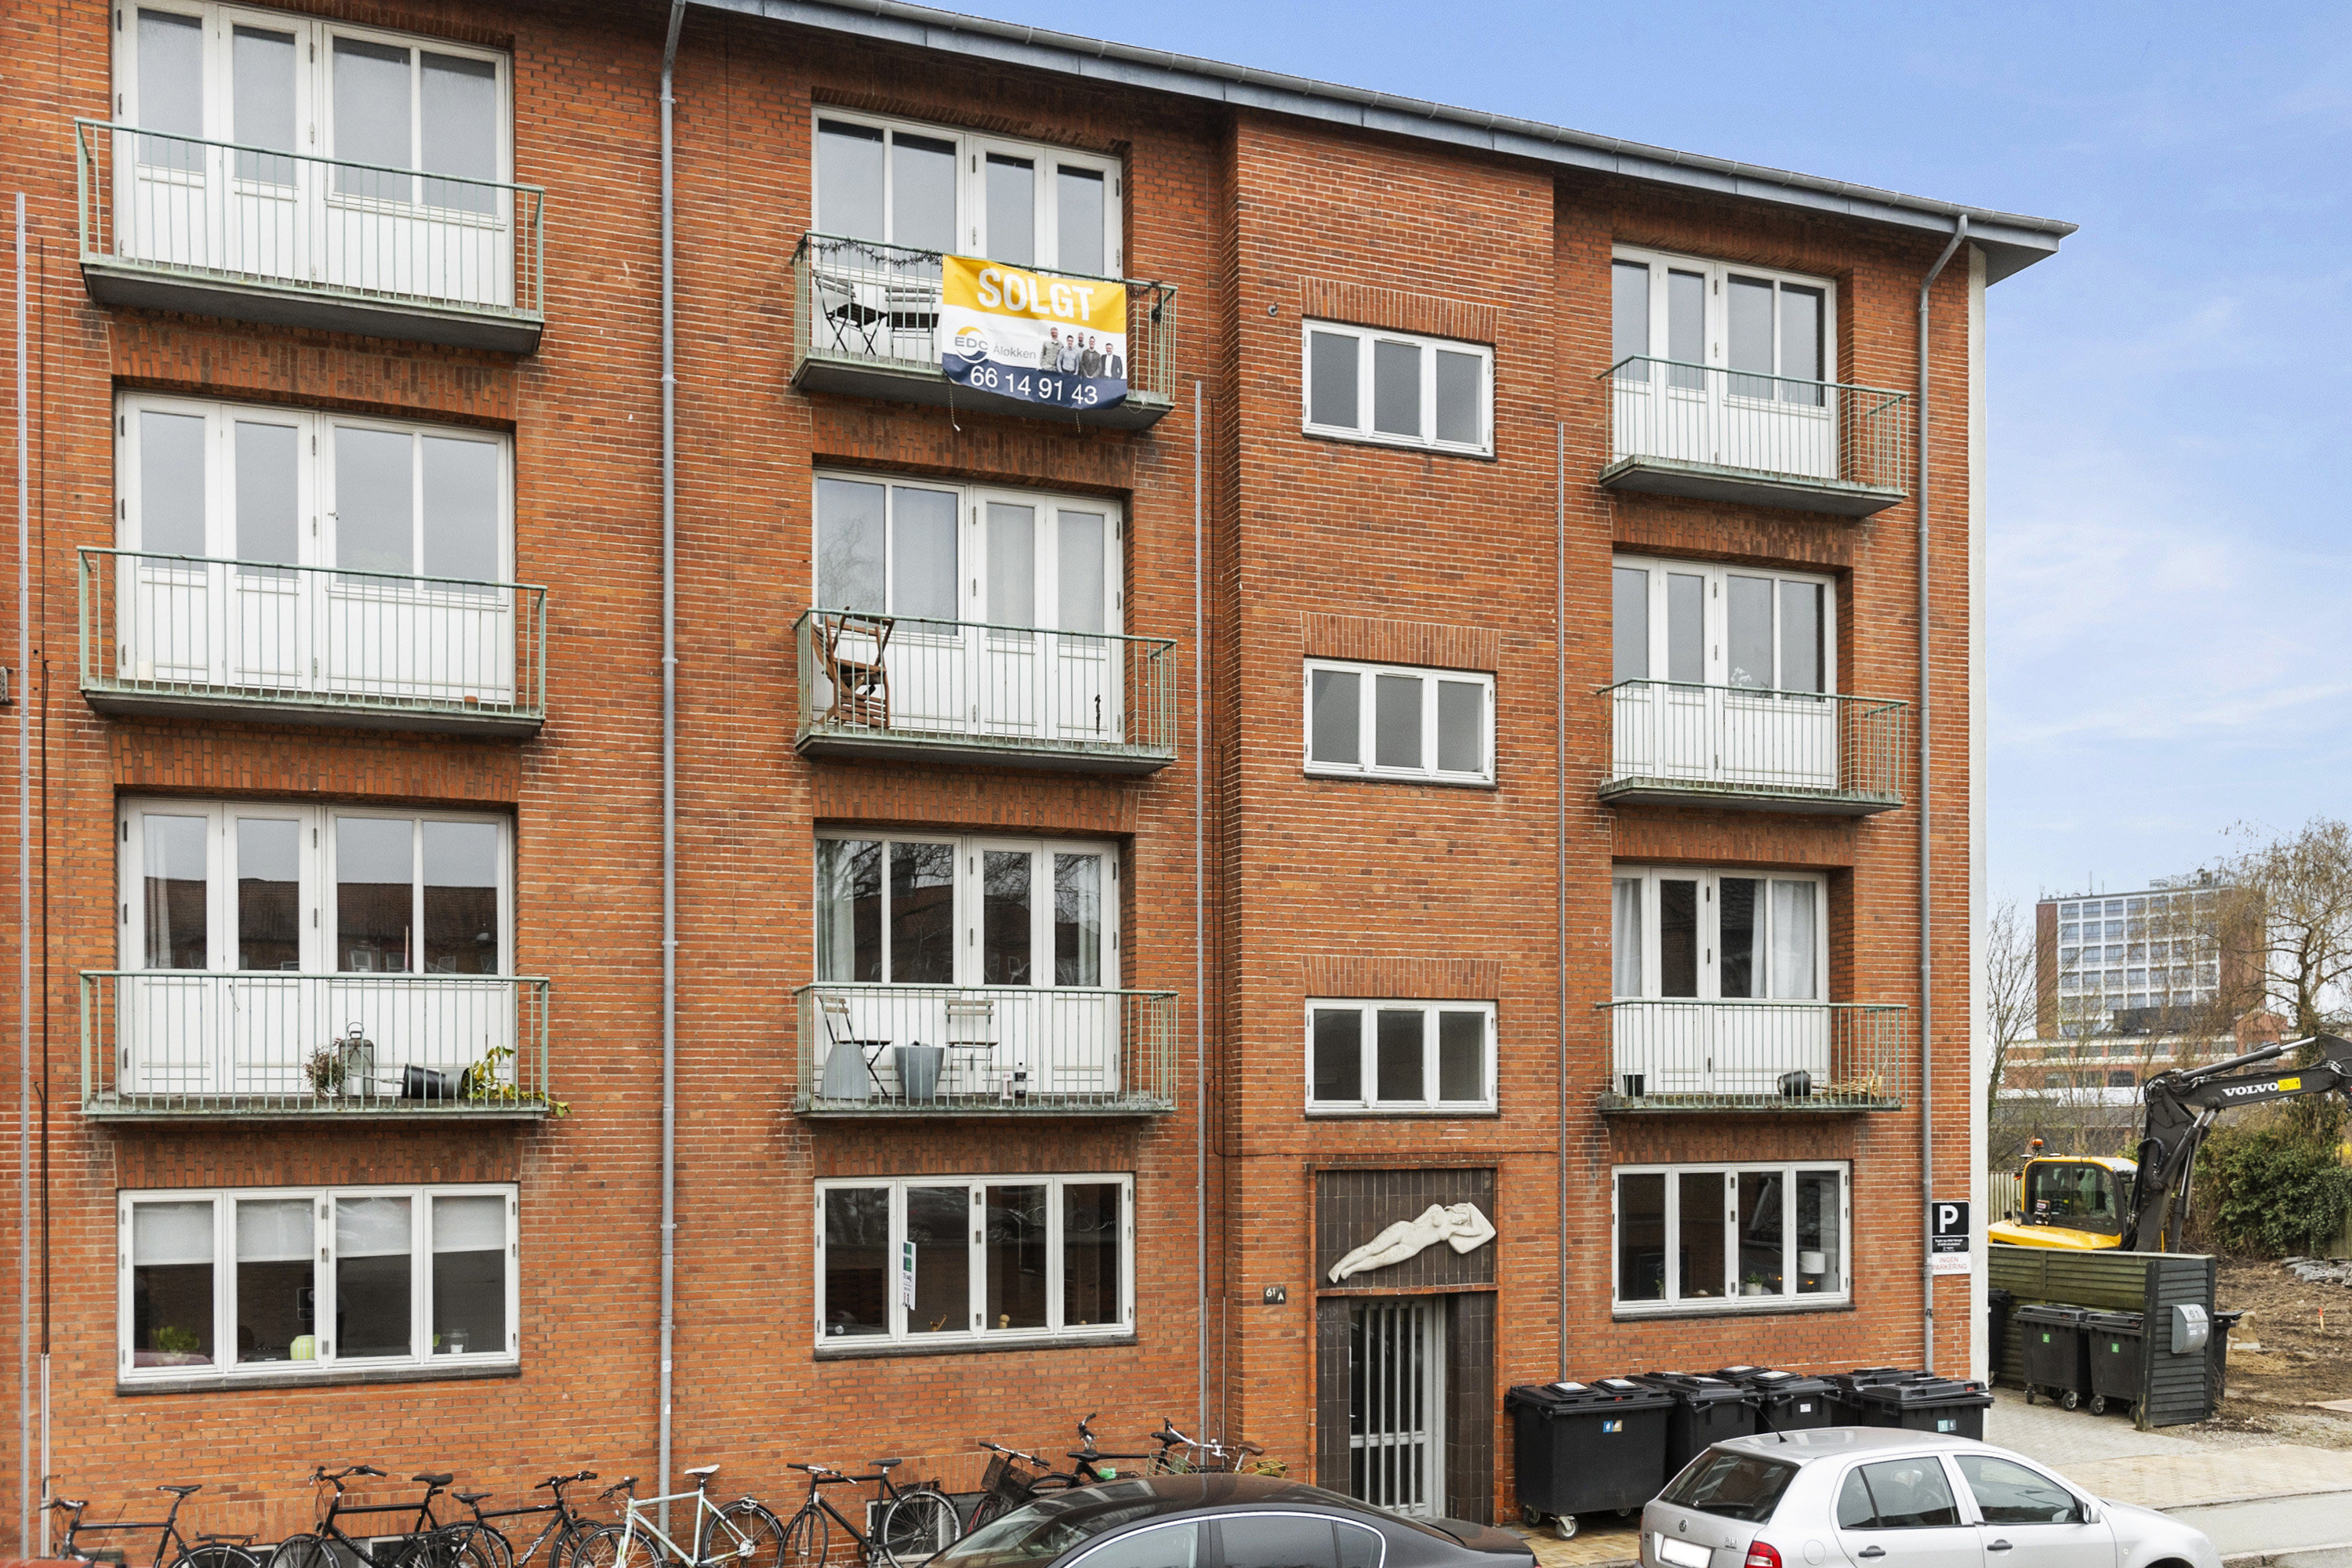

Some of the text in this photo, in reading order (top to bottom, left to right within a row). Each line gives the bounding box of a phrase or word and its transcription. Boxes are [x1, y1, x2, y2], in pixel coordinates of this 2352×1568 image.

[978, 268, 1094, 321] SOLGT
[954, 336, 989, 351] EDC
[970, 365, 1098, 405] 66 14 91 43
[2222, 1082, 2279, 1097] VOLVO
[1939, 1204, 1959, 1233] P
[2189, 1309, 2200, 1318] 61
